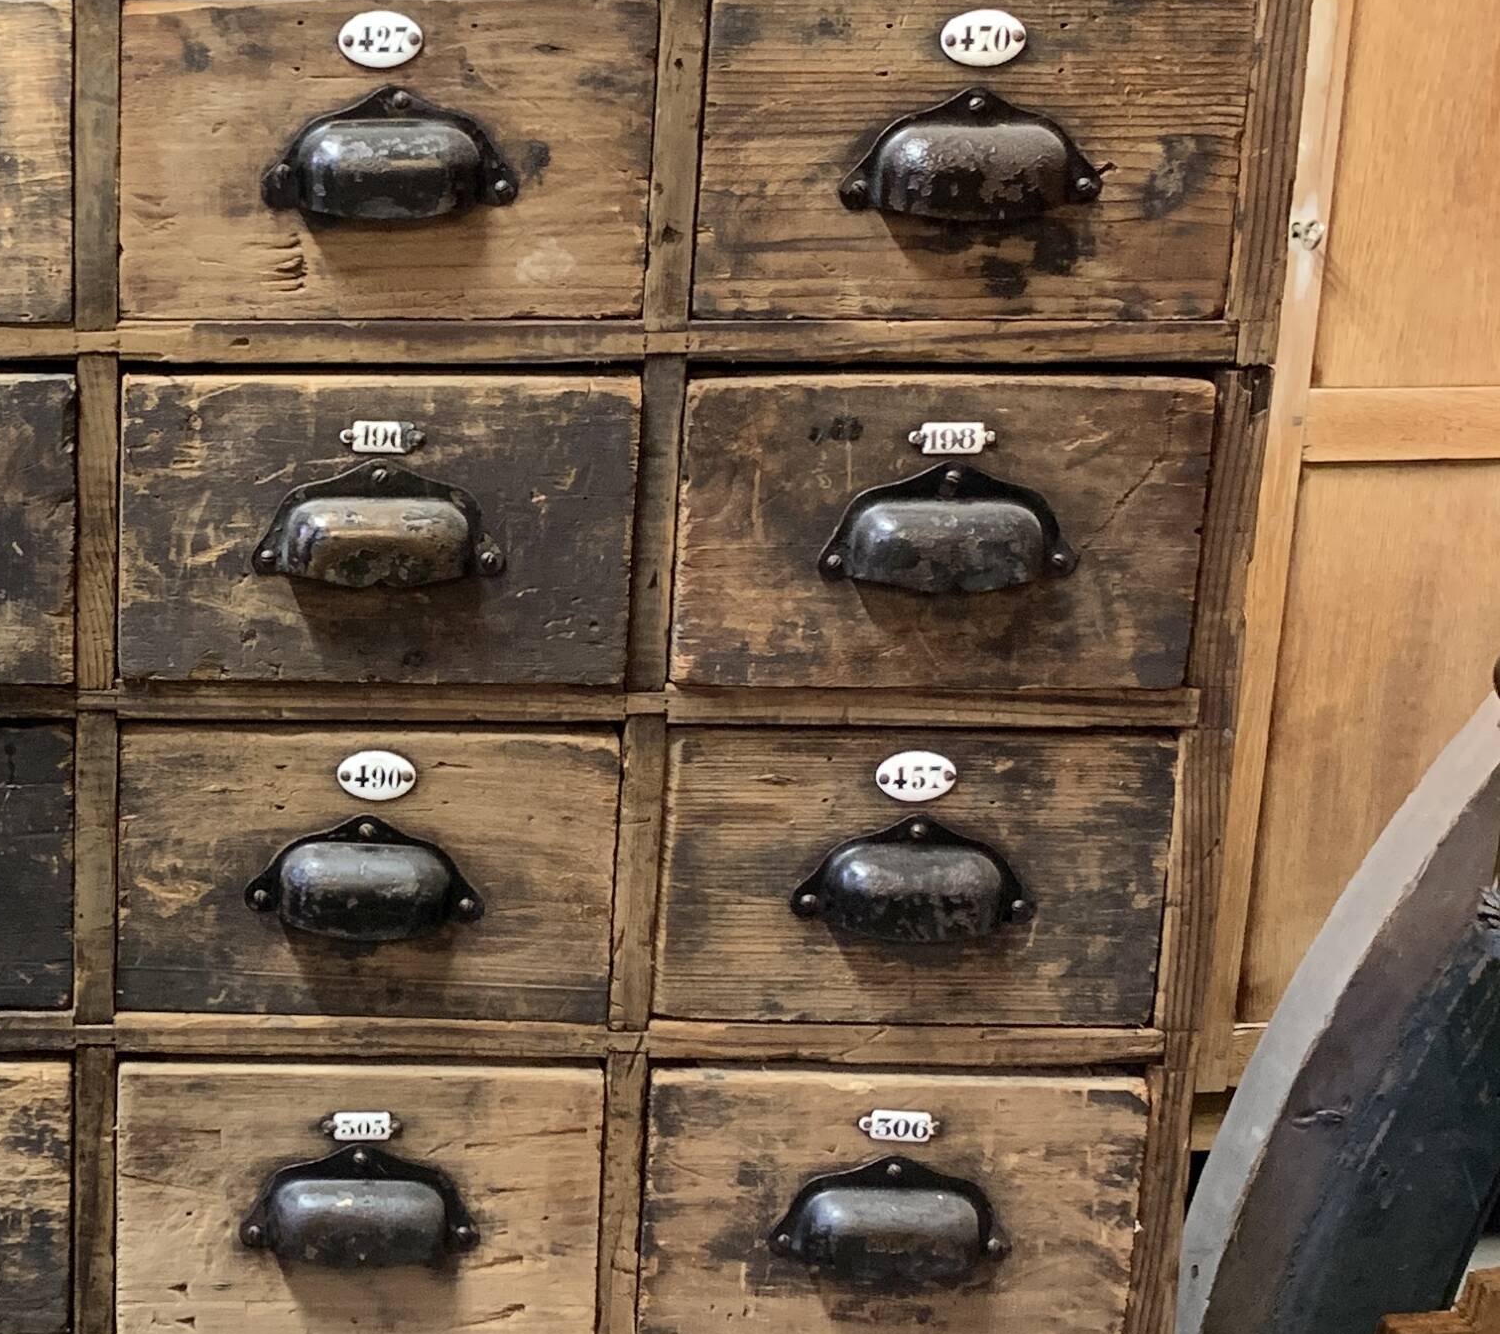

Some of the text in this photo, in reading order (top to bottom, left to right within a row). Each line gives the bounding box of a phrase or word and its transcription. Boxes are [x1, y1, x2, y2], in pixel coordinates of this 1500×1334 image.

[358, 26, 408, 53] 427
[960, 25, 1010, 51] 470
[929, 428, 975, 450] 198
[355, 765, 402, 789] 490
[893, 766, 941, 789] 457
